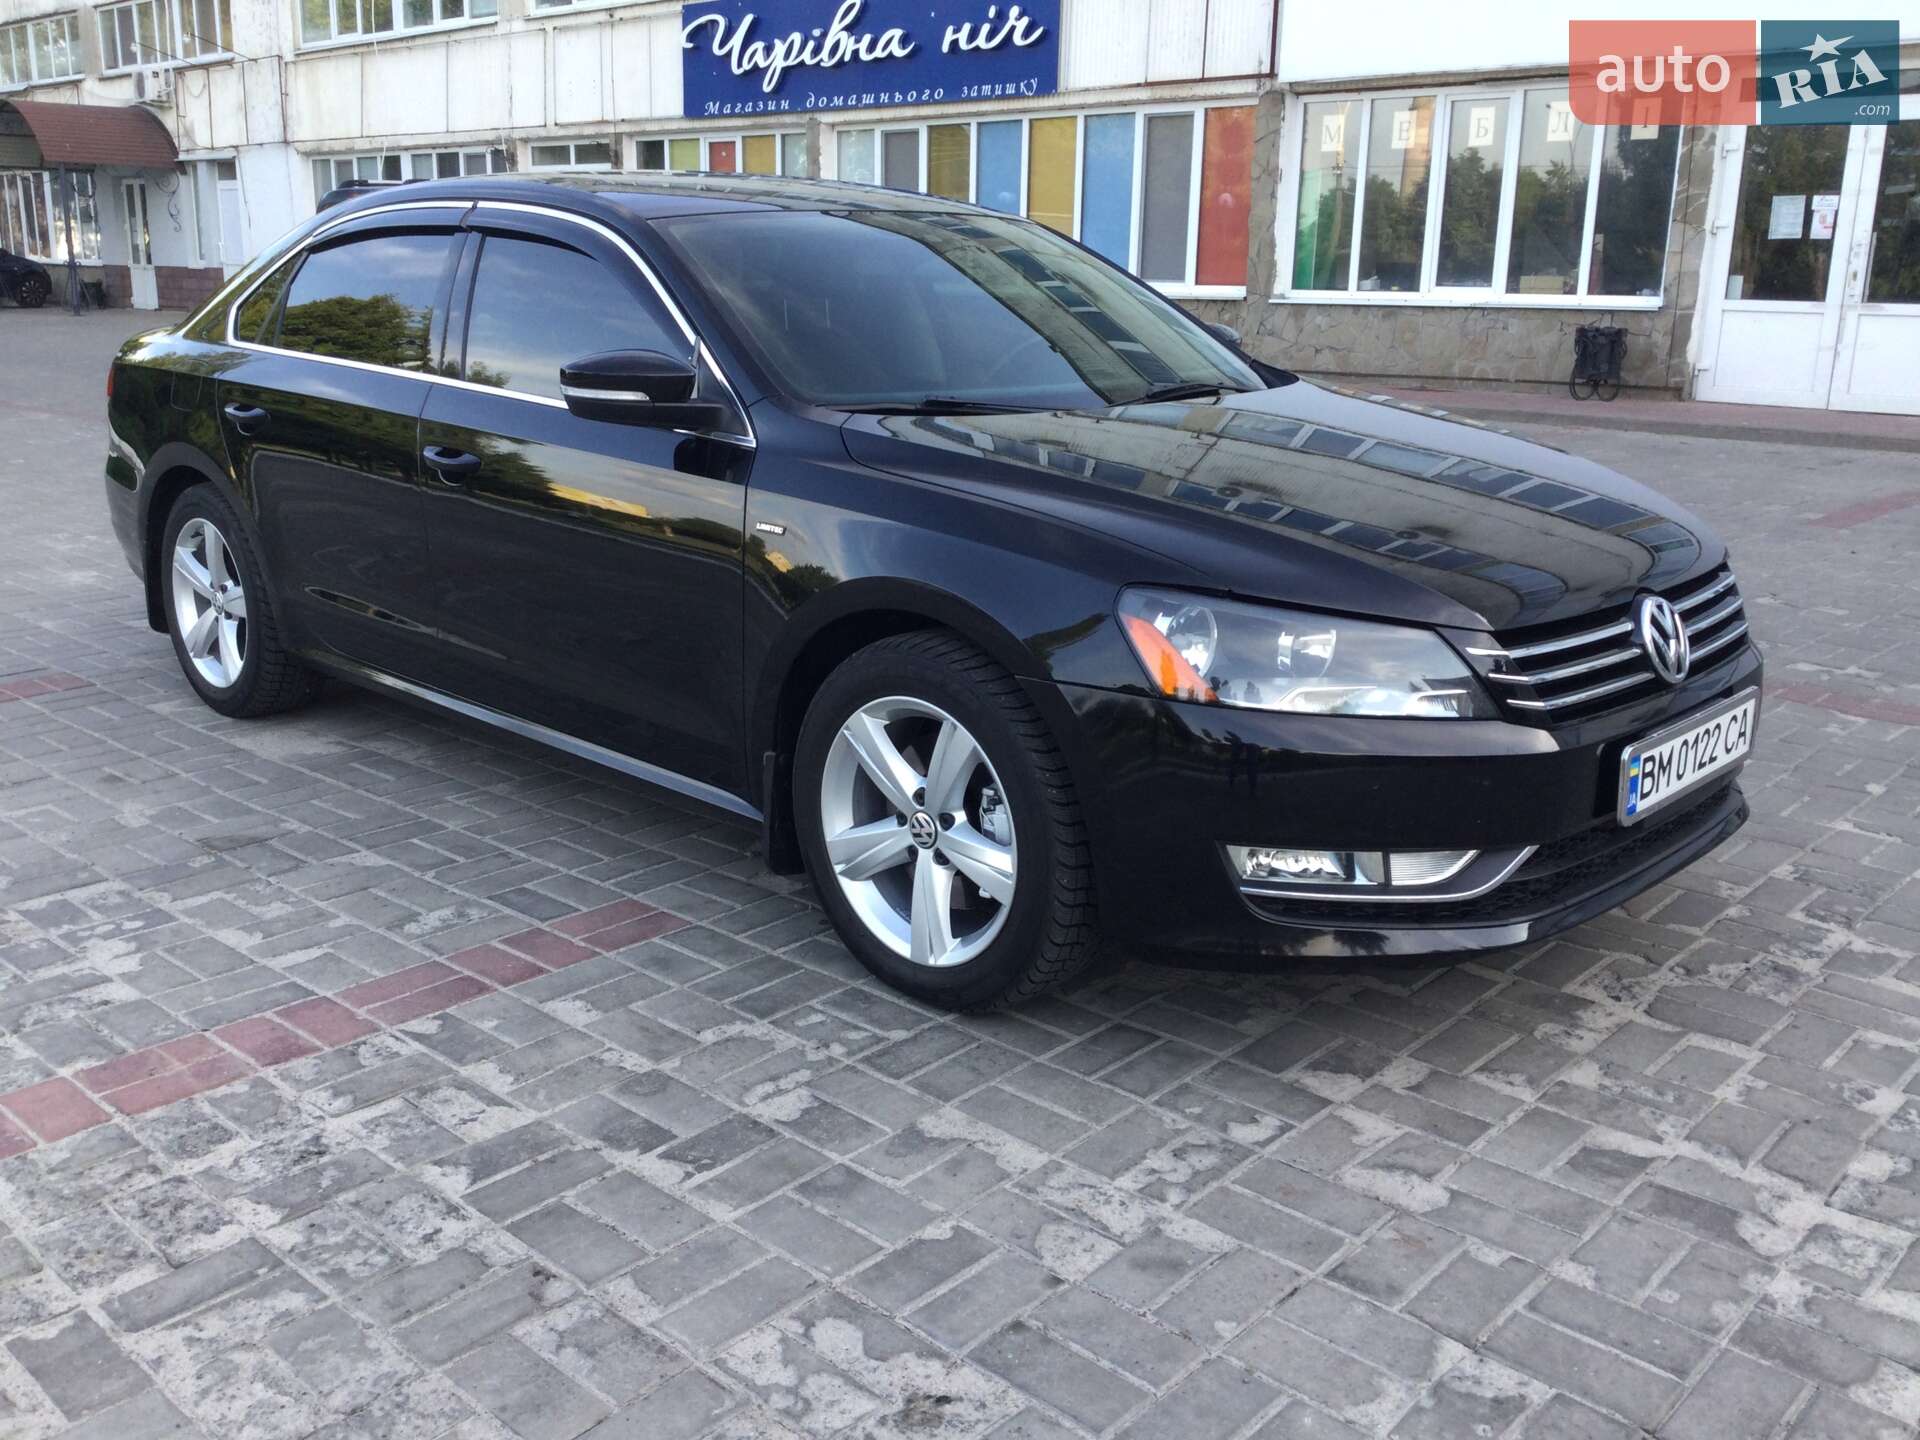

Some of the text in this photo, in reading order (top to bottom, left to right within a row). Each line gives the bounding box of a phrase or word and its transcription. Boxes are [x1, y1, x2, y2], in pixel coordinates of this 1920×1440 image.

[681, 0, 1045, 93] Чарівна ніч
[704, 77, 1039, 116] Магазин домашнього затишку
[1640, 708, 1748, 801] BM 0122 CA
